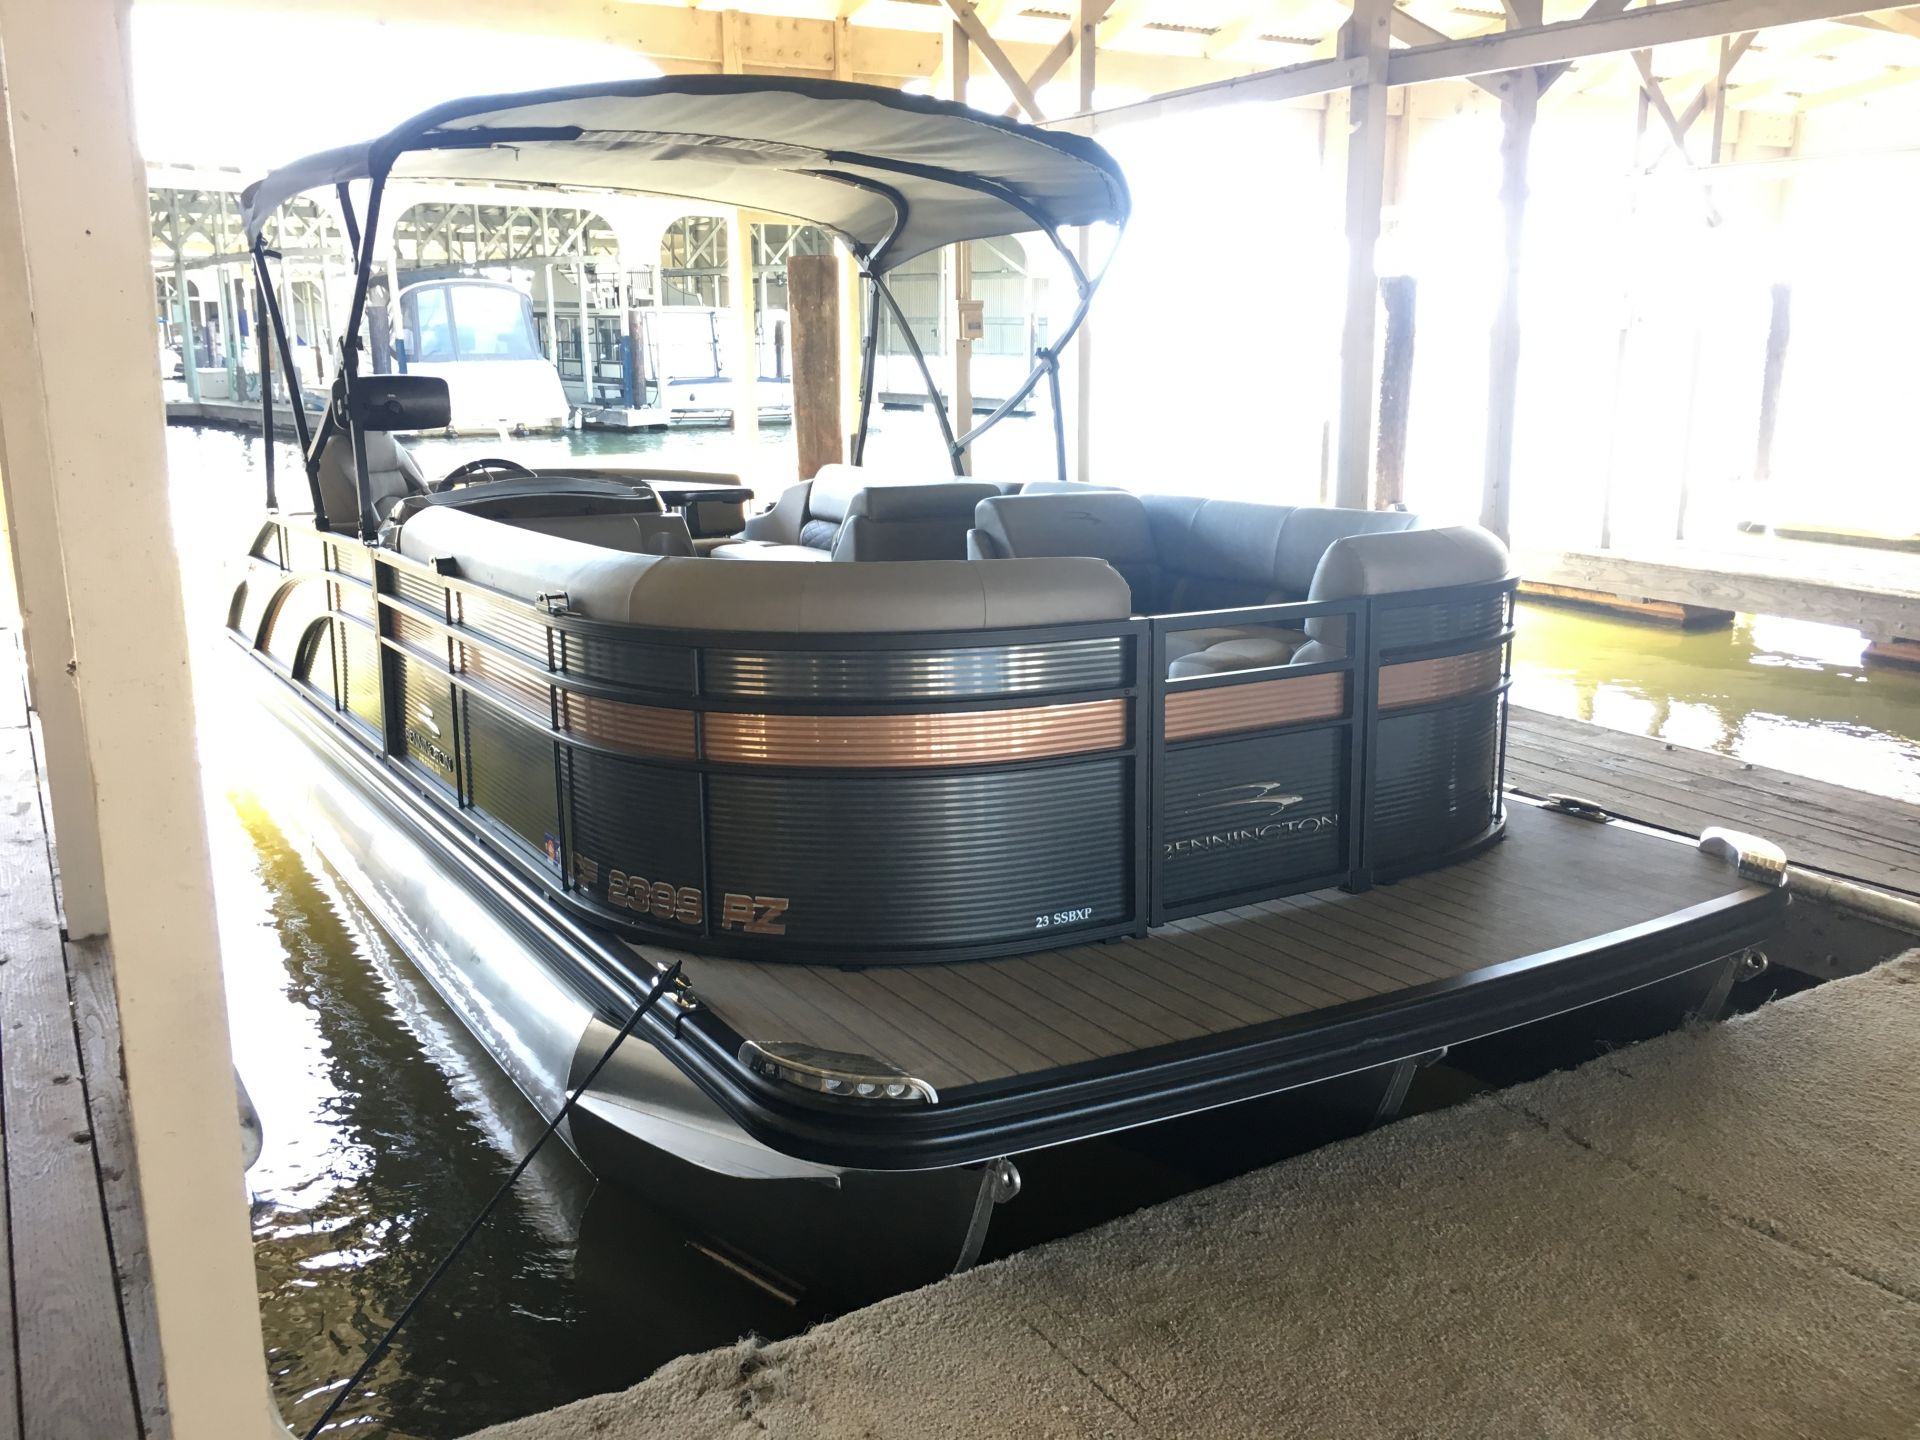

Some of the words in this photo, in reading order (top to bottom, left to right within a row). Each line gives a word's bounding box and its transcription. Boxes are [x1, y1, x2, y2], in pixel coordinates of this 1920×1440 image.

[722, 892, 790, 936] RZ
[1035, 916, 1049, 928] 23
[1053, 907, 1092, 924] SSBXP
